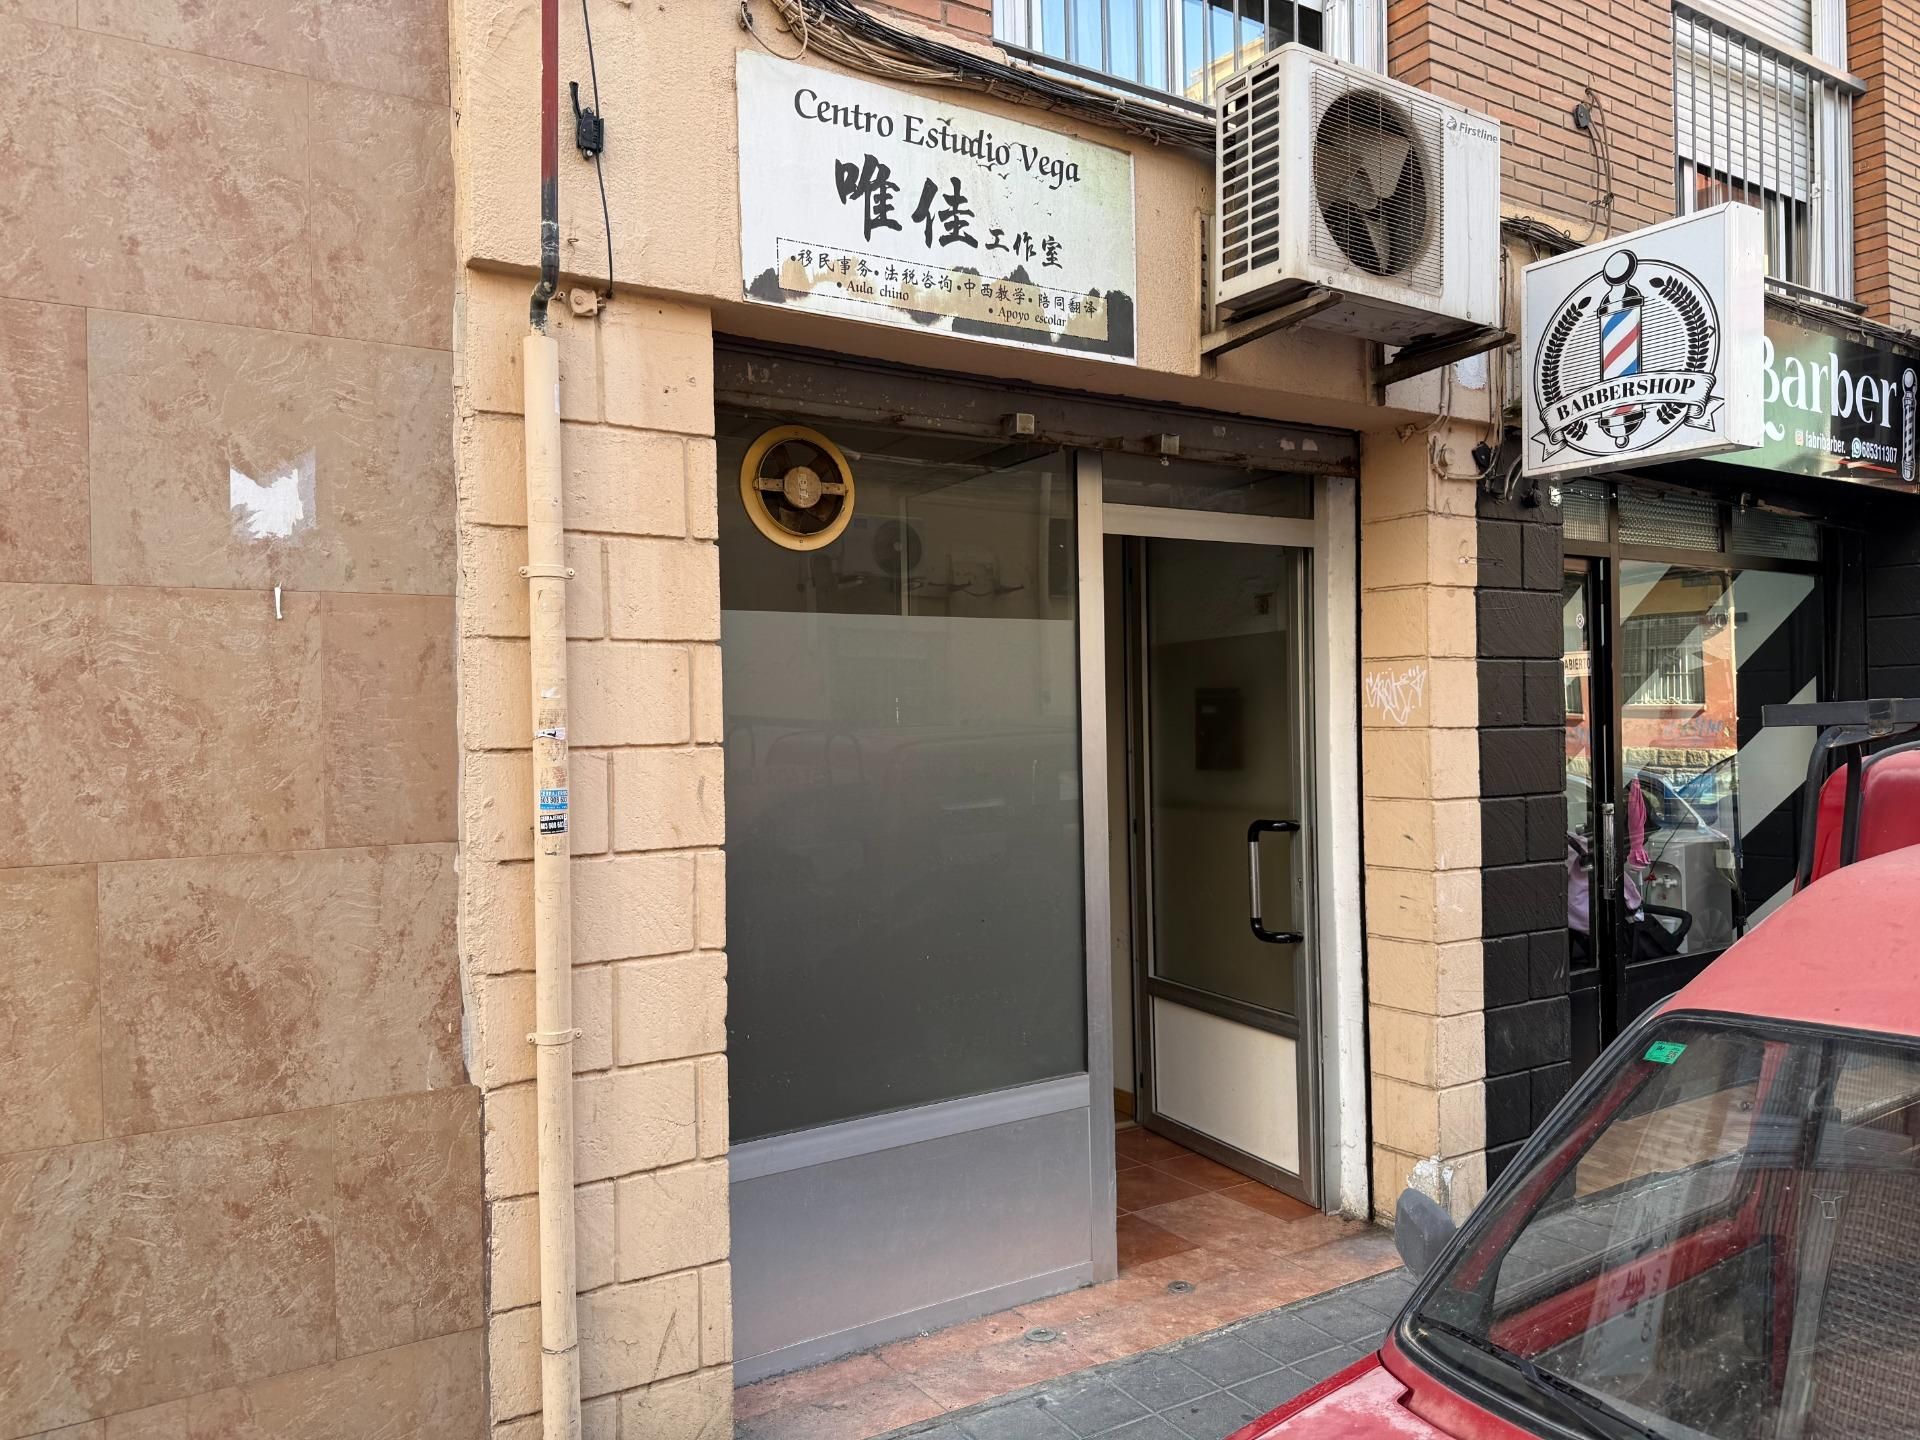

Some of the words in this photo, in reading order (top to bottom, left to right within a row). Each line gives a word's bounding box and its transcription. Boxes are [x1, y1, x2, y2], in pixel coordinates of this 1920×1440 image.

[794, 88, 893, 137] Centro
[902, 114, 1010, 166] Estudio
[1018, 143, 1081, 190] Vega
[1459, 121, 1498, 144] Firstline
[985, 228, 1063, 270] 工作室
[846, 280, 874, 296] Aula
[879, 284, 910, 301] chino
[997, 306, 1030, 325] Apoyo
[1034, 313, 1067, 327] escolar
[1556, 377, 1696, 422] BARBERSHOP
[1565, 657, 1591, 671] ABIERTO
